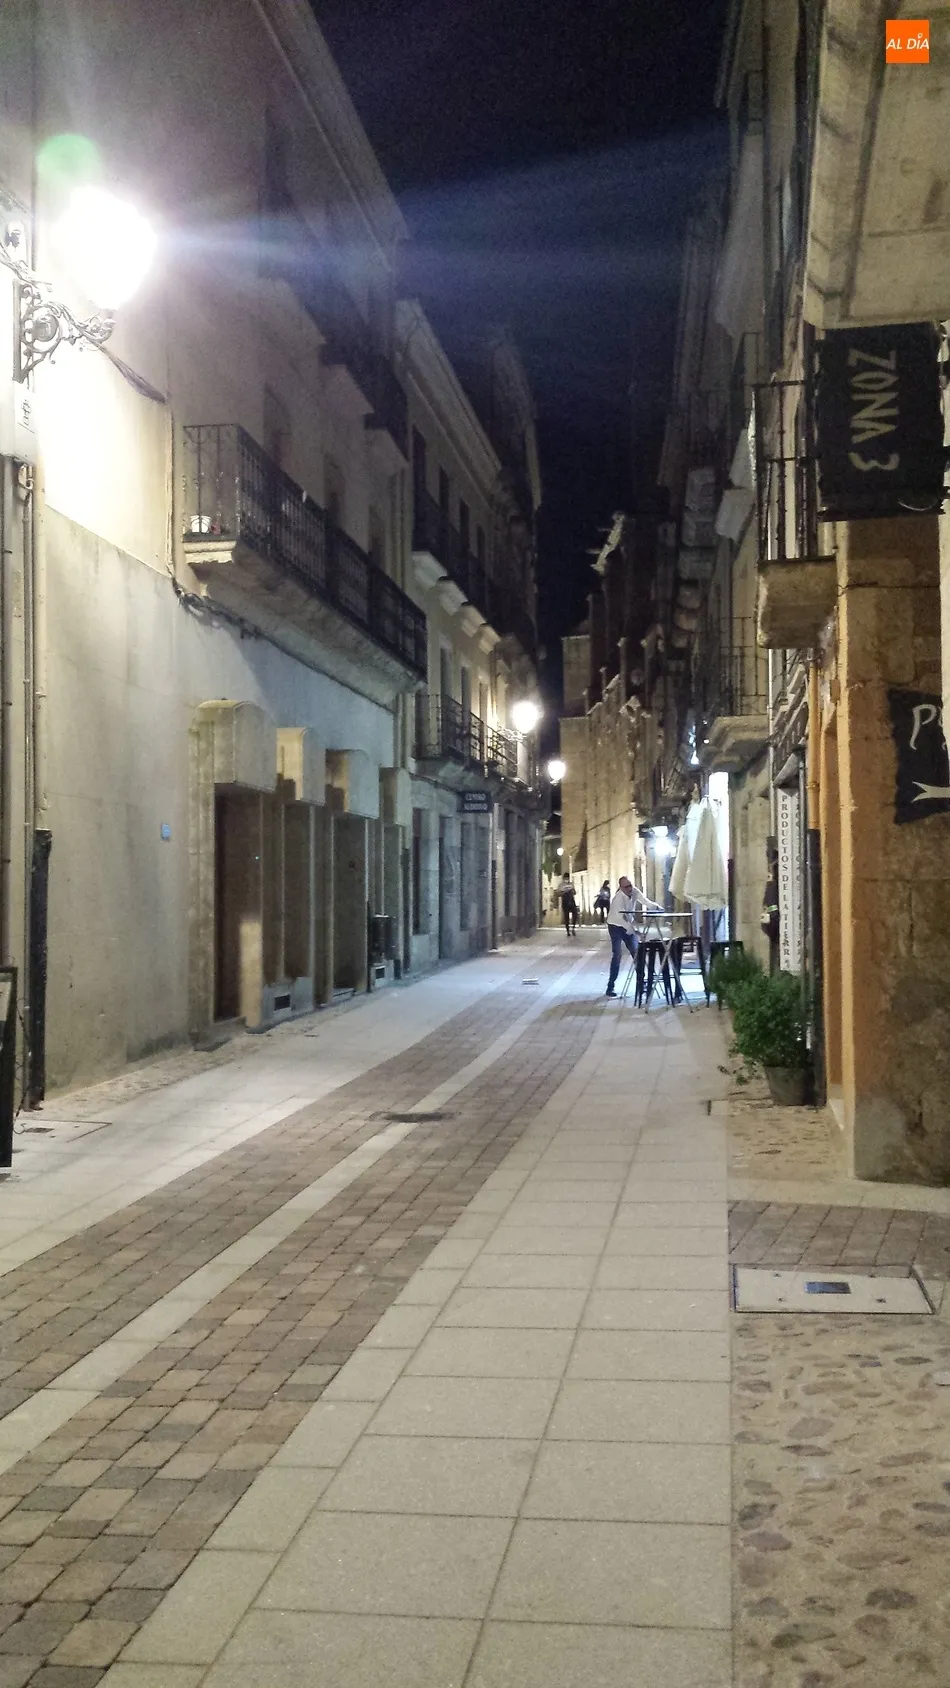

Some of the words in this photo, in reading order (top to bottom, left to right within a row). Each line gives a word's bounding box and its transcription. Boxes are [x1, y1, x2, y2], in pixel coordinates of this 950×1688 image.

[849, 348, 899, 444] ZONA
[910, 703, 944, 750] P
[780, 795, 789, 872] PRODUCTOS
[782, 875, 789, 891] DE
